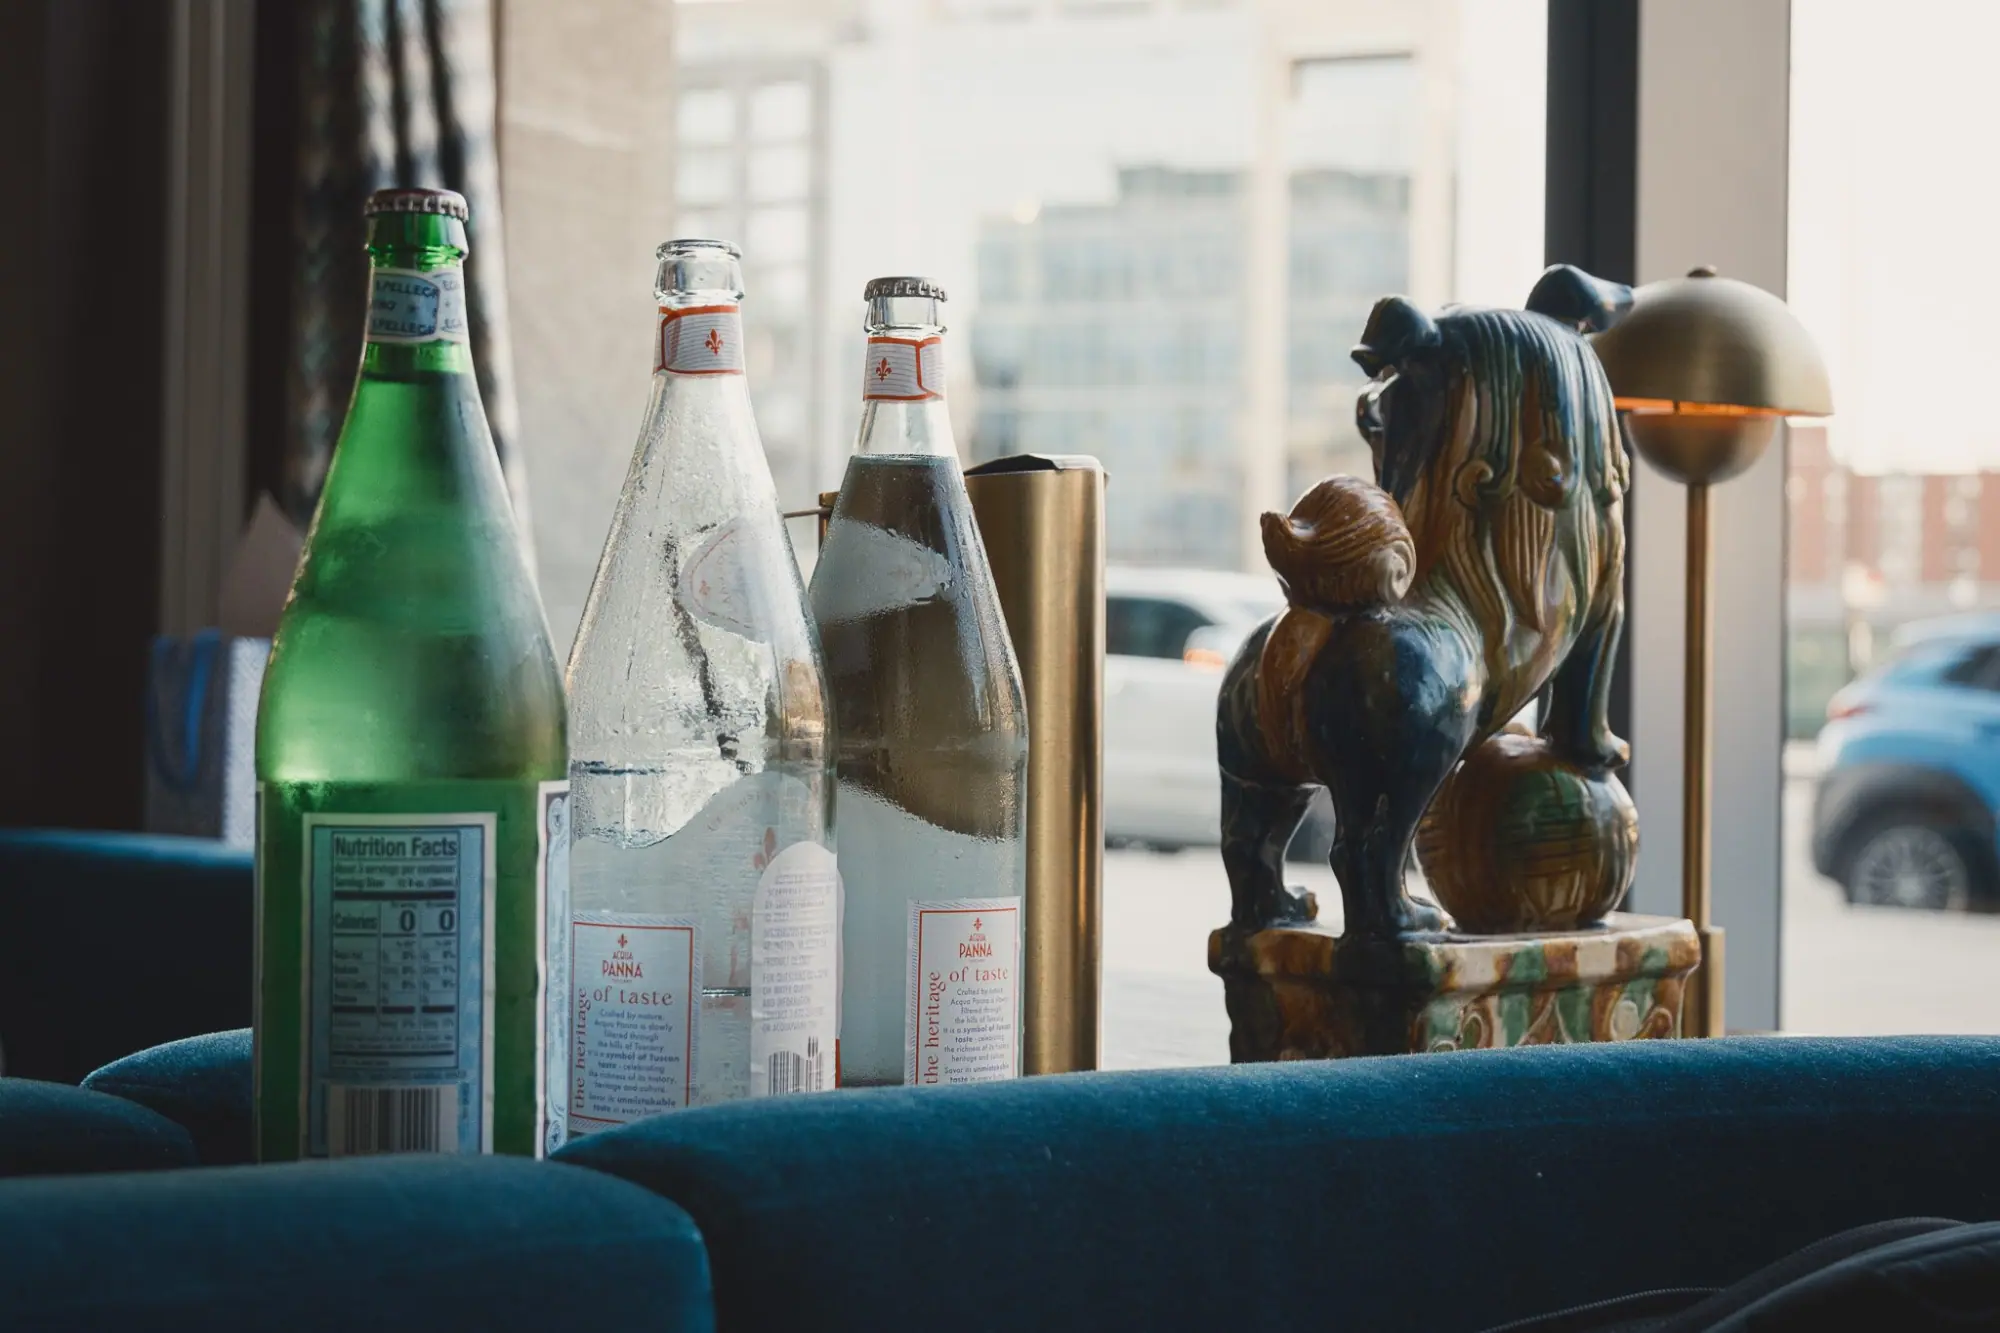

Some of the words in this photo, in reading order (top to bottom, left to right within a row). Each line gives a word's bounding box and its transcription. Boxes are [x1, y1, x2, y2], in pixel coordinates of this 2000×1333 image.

[335, 836, 406, 856] Nutrition
[411, 837, 457, 856] Facts
[400, 910, 416, 931] 0
[439, 909, 455, 931] 0
[612, 951, 633, 960] ACQUA
[959, 943, 993, 958] PANNA
[602, 960, 643, 978] PANNA
[949, 966, 969, 982] of
[975, 967, 1009, 982] taste
[593, 985, 612, 1002] of
[619, 990, 673, 1006] taste
[950, 997, 971, 1006] Acqua
[924, 970, 946, 1048] heritage
[576, 987, 591, 1072] heritage
[963, 1025, 987, 1034] symbol
[606, 1051, 635, 1061] symbol
[944, 1045, 955, 1053] the
[924, 1053, 939, 1084] the
[944, 1066, 963, 1074] Savor
[574, 1077, 585, 1109] the
[617, 1096, 676, 1107] unmistakable
